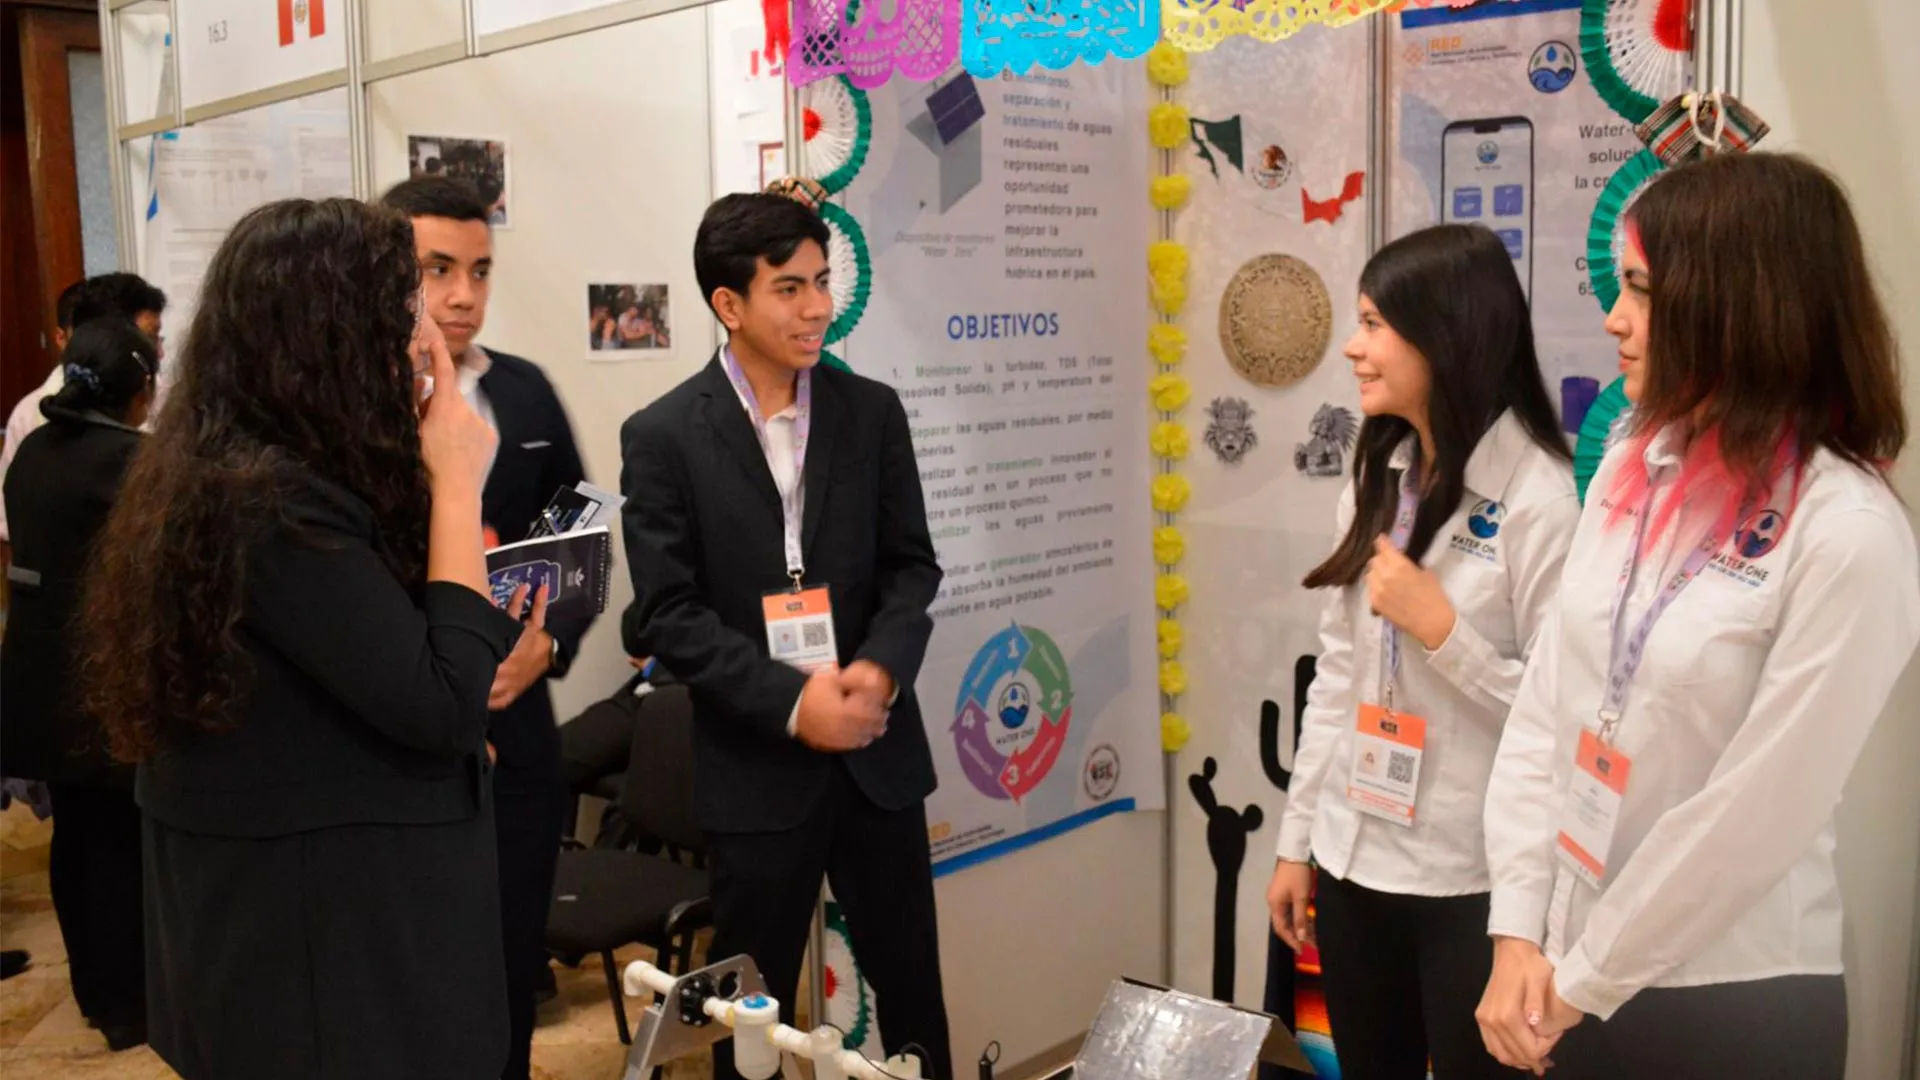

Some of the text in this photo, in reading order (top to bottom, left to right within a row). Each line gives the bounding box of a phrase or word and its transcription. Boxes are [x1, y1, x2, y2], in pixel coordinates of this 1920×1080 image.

[1003, 113, 1112, 136] tratamiento de aguas
[1003, 136, 1059, 152] residuales
[1004, 159, 1090, 174] representan una
[1004, 180, 1069, 195] oportunidad
[1575, 175, 1588, 190] la
[1005, 202, 1098, 219] prometedora para
[1005, 224, 1059, 239] mejorar la
[1005, 244, 1084, 258] infraestructura
[1046, 269, 1059, 280] en
[1061, 267, 1071, 279] el
[947, 312, 1059, 340] OBJETIVOS
[892, 367, 902, 380] 1.
[916, 364, 972, 379] Monitorear
[984, 362, 994, 374] la
[1058, 356, 1078, 369] TDS
[1022, 381, 1029, 393] y
[1037, 374, 1093, 391] temperatura
[1099, 373, 1113, 385] del
[956, 423, 971, 435] las
[977, 420, 1006, 434] aguas
[1067, 412, 1082, 425] por
[1086, 409, 1113, 422] medio
[920, 466, 956, 481] ealizar
[965, 465, 978, 476] un
[986, 458, 1043, 473] tratamiento
[1050, 450, 1097, 465] innovador
[931, 468, 1113, 499] residual en un proceso que no
[949, 506, 961, 517] un
[965, 500, 1006, 516] proceso
[985, 520, 1000, 532] las
[1015, 514, 1044, 528] aguas
[1057, 501, 1113, 522] previamente
[1451, 534, 1481, 550] WATER
[974, 562, 986, 573] un
[990, 552, 1041, 572] generador
[1102, 538, 1113, 549] de
[951, 579, 992, 597] absorba
[996, 577, 1004, 588] la
[1008, 569, 1052, 585] humedad
[1056, 565, 1069, 577] del
[1072, 556, 1113, 574] ambiente
[1711, 552, 1744, 571] WATER
[1744, 564, 1770, 582] ONE
[974, 601, 986, 613] en
[989, 596, 1012, 610] agua
[1007, 639, 1019, 659] 1
[1050, 689, 1064, 710] 2
[962, 710, 976, 730] 4
[996, 732, 1019, 746] WATER
[1006, 767, 1020, 786] 3
[930, 821, 951, 842] ED
